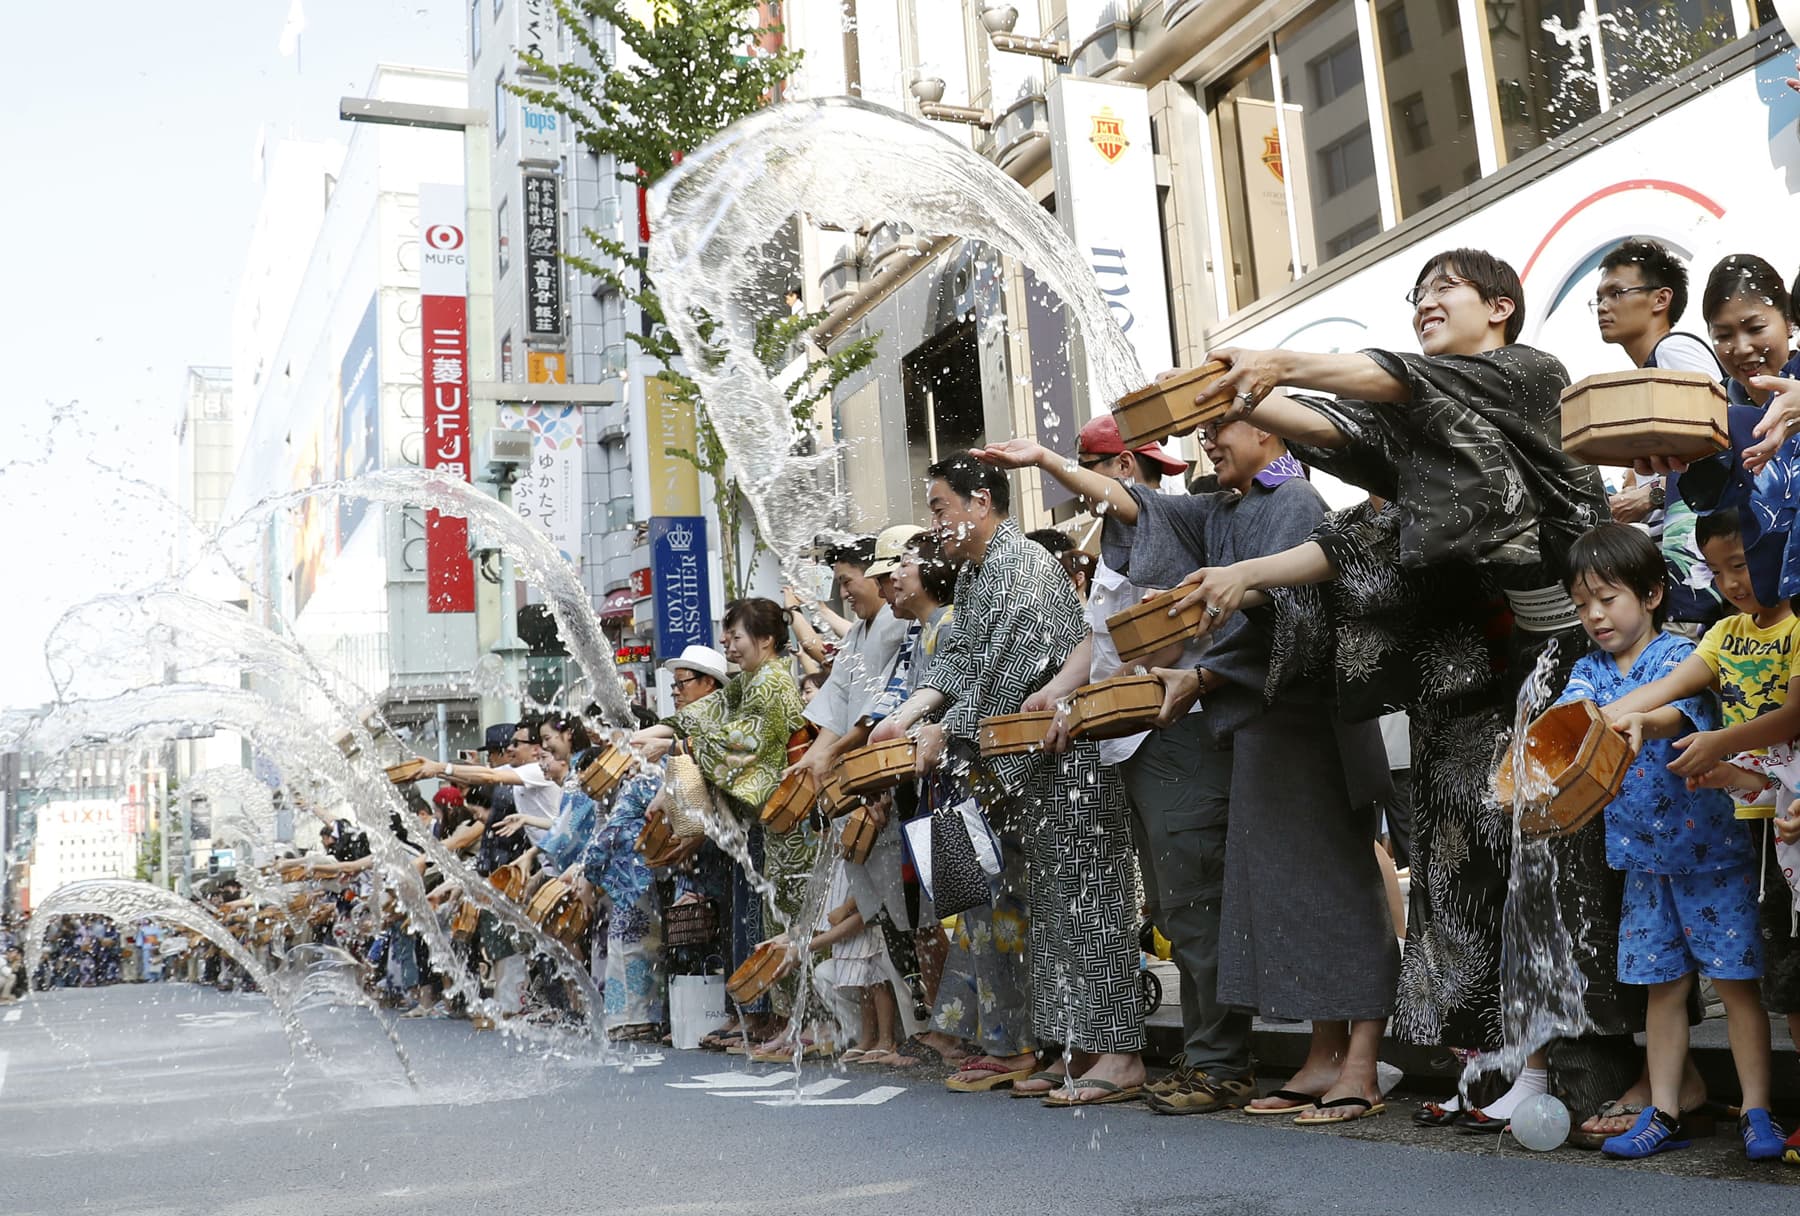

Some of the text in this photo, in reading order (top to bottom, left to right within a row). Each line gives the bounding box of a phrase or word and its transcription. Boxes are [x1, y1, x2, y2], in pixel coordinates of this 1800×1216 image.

[425, 253, 465, 265] MUFG
[432, 329, 466, 482] 三菱UFJ銀
[538, 453, 556, 528] ゆかたで
[666, 567, 684, 633] ROYAL
[60, 808, 113, 823] LIXIL
